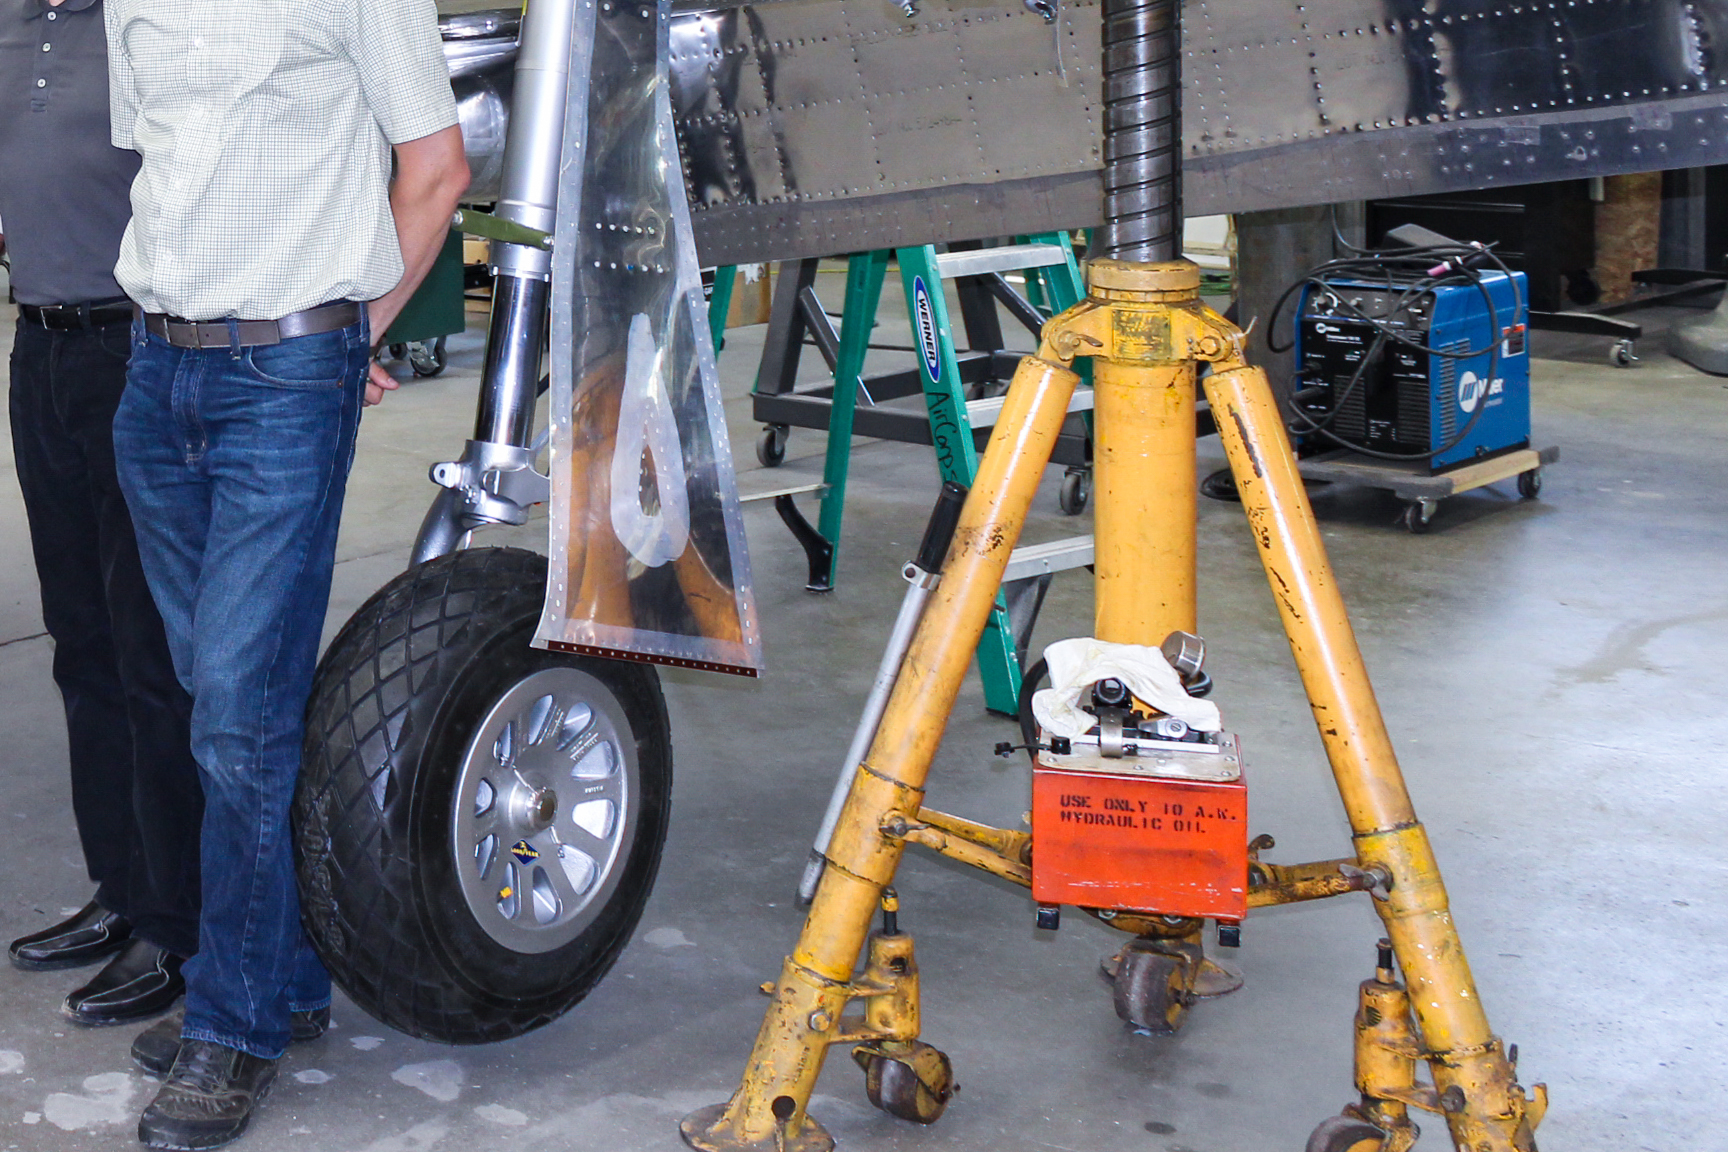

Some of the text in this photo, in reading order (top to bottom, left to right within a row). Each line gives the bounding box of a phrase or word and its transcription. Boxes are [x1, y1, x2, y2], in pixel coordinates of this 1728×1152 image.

[918, 297, 937, 362] WERNER
[1060, 794, 1092, 809] USE
[1104, 797, 1148, 813] ONLY
[1060, 809, 1207, 834] HYDRAULIC OIL
